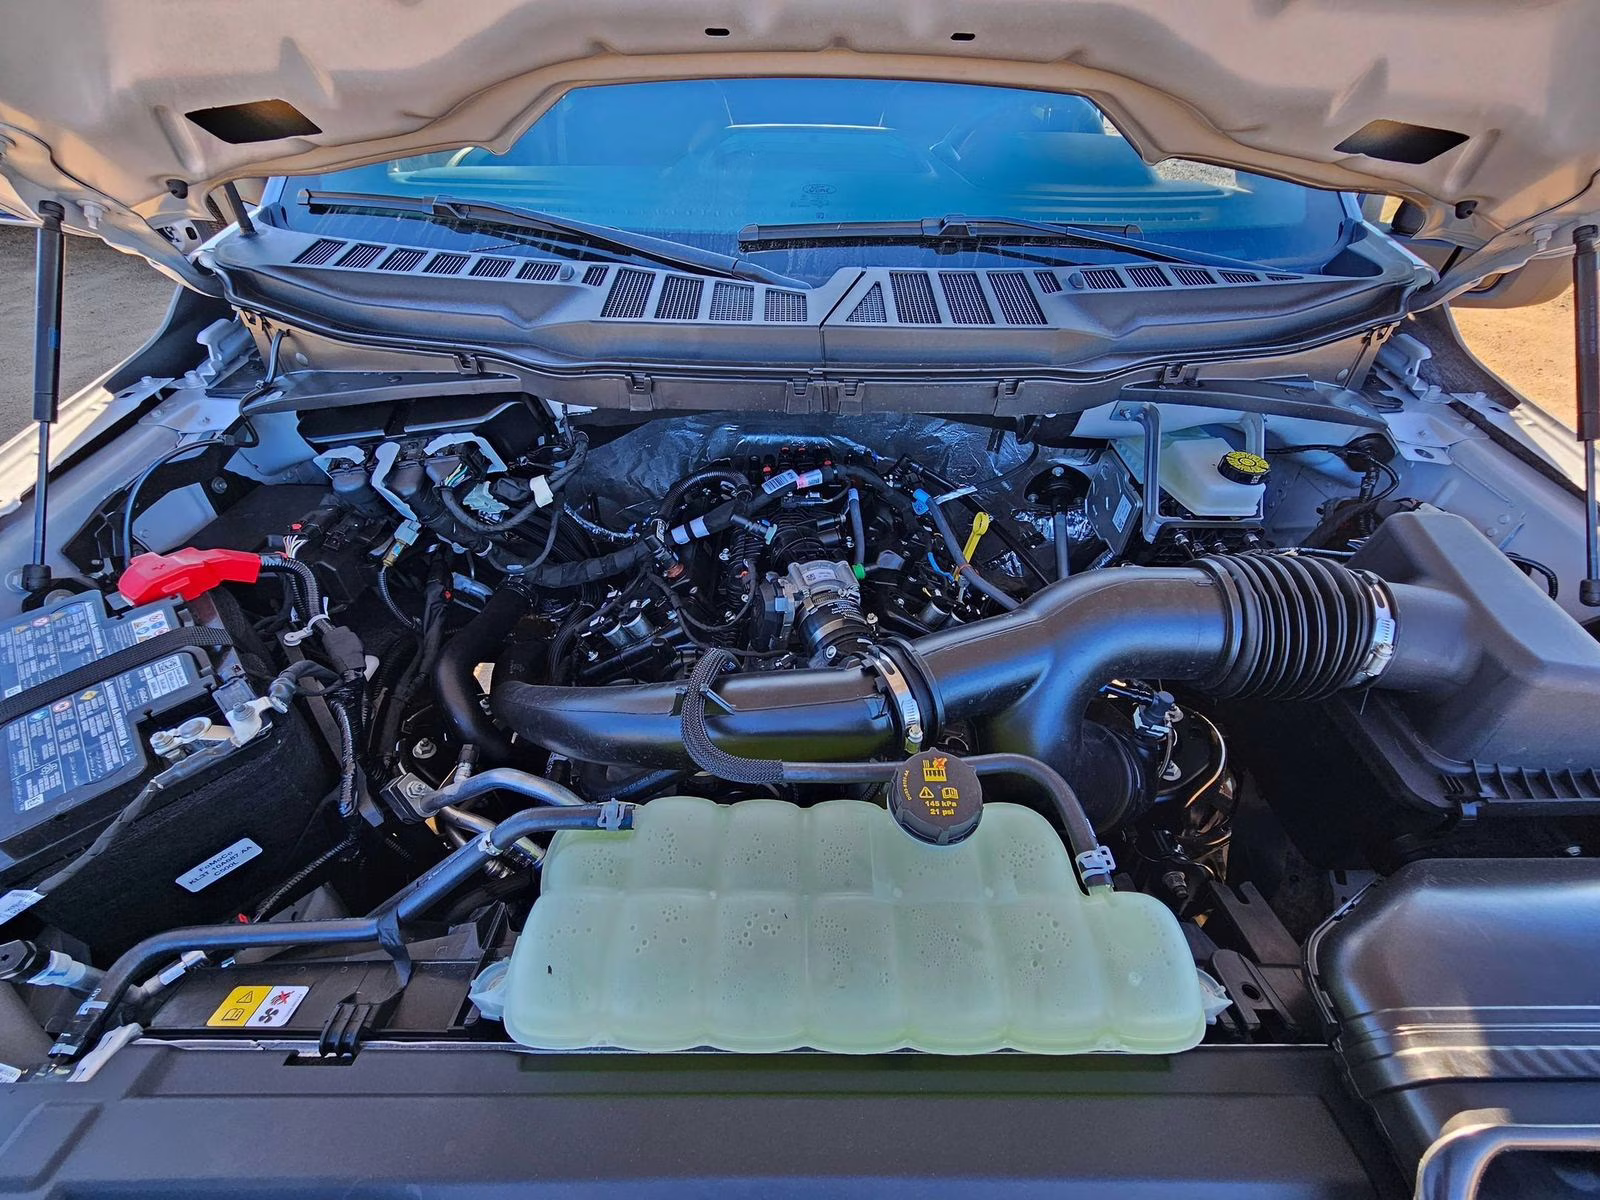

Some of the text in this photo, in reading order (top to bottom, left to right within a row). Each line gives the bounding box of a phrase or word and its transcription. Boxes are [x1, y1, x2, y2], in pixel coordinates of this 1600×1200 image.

[941, 808, 955, 816] psi
[189, 872, 209, 885] KL3T
[241, 846, 252, 854] AA
[198, 851, 233, 872] FoMoCo
